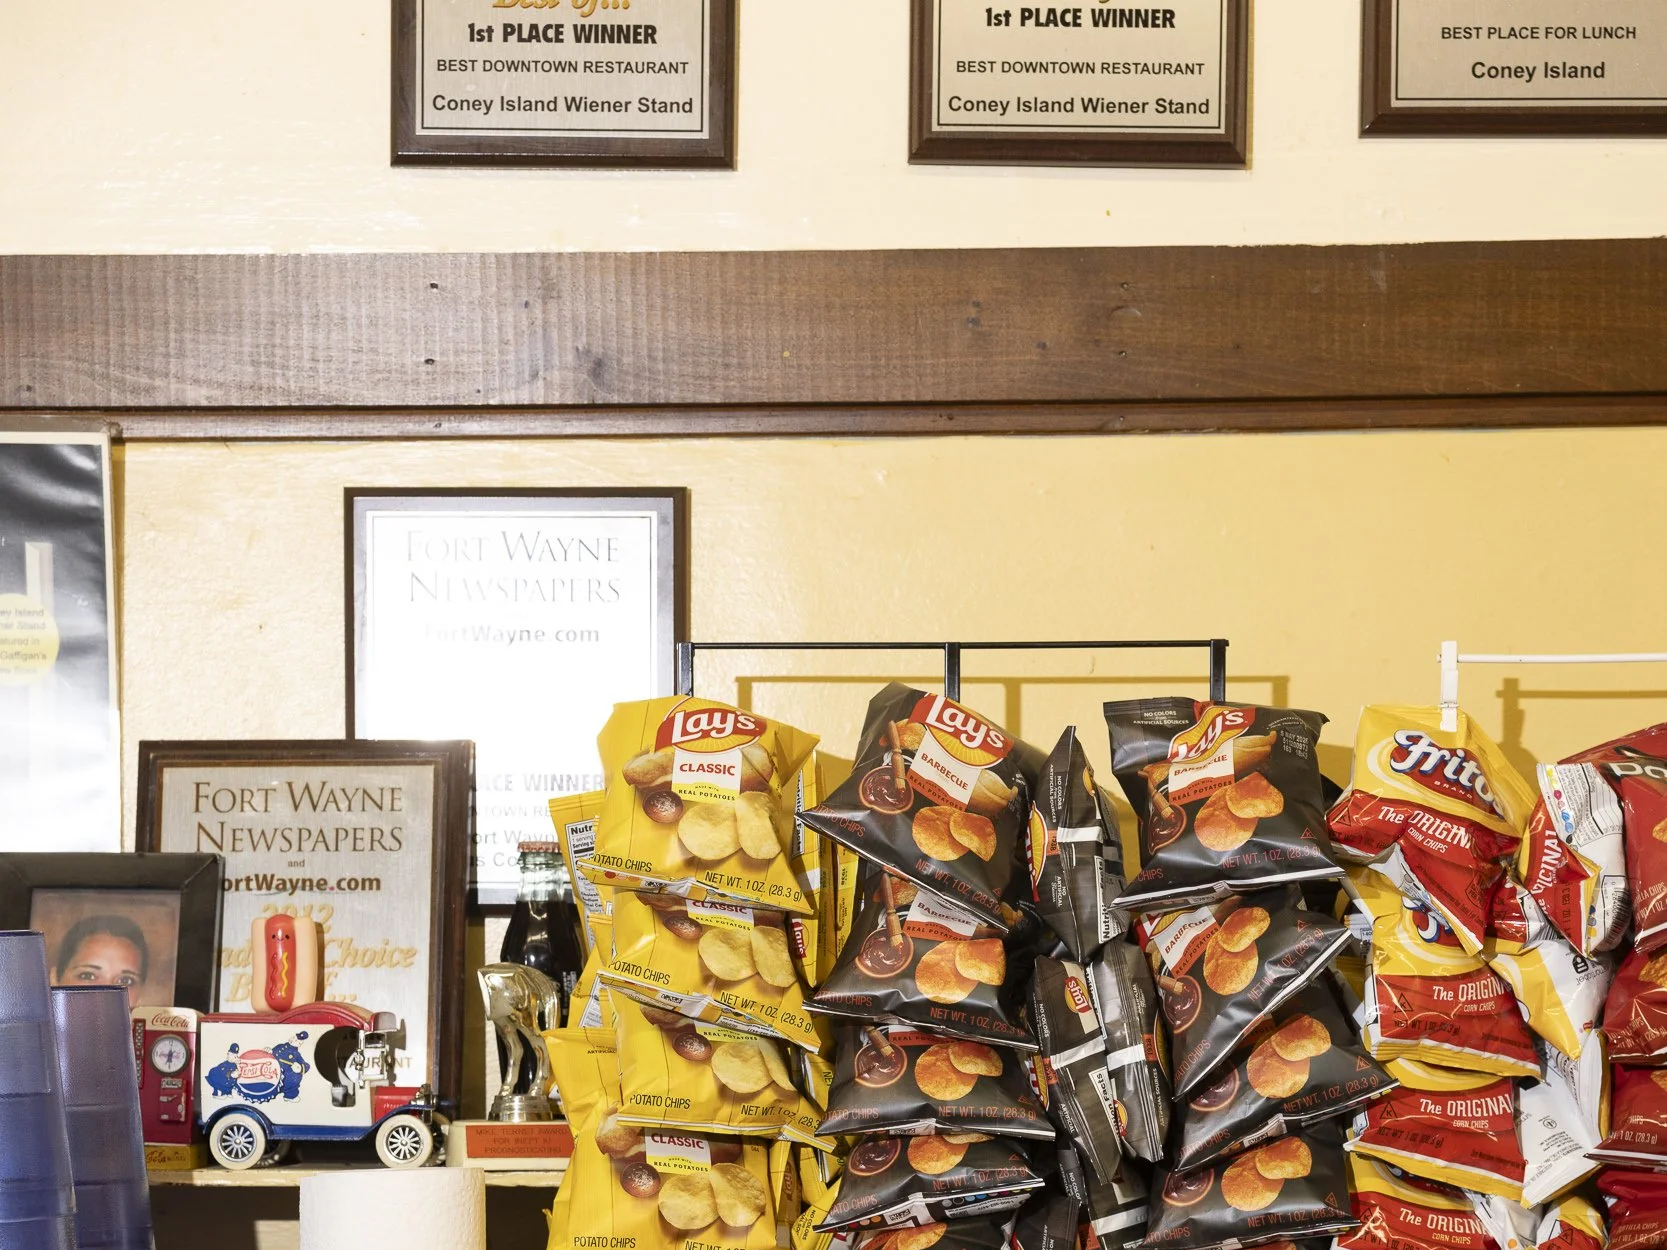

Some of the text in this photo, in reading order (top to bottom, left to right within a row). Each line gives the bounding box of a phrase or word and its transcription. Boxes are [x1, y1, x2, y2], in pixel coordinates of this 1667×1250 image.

[985, 8, 1175, 29] 1st PLACE WINNER
[468, 23, 657, 44] 1st PLACE WINNER
[1441, 27, 1637, 39] BEST PLACE FOR LUNCH
[436, 59, 689, 75] BEST DOWNTOWN RESTAURANT
[956, 60, 1204, 75] BEST DOWNTOWN RESTAURANT
[1471, 61, 1605, 83] Coney Island
[432, 94, 693, 115] Coney Island Wiener Stand
[949, 95, 1210, 116] Coney Island Wiener Stand
[672, 711, 757, 744] Lay's
[679, 763, 736, 776] CLASSIC
[921, 753, 969, 791] BARBECUE
[523, 774, 605, 791] WINNER
[286, 781, 404, 813] WAYNE
[678, 789, 736, 801] REAL POTATOES
[1378, 805, 1404, 825] The
[195, 821, 404, 852] NEWSPAPERS
[839, 815, 866, 838] CHIPS
[1408, 827, 1424, 843] CORN
[1423, 834, 1449, 854] CHIPS
[287, 858, 305, 868] and
[625, 859, 652, 873] CHIPS
[915, 858, 934, 876] NET
[1137, 853, 1261, 882] CHIPS NET WT.
[222, 872, 381, 896] ortWayne.com
[705, 870, 791, 899] NET WT. OZ. (28.3
[643, 968, 671, 985] CHIPS
[1432, 985, 1454, 1001] The
[721, 990, 803, 1029] NET WT. OZ. (28.3
[846, 994, 967, 1025] CHIPS NET WT.
[1479, 1001, 1496, 1012] CHIPS
[1190, 1039, 1213, 1065] CHIPS
[1284, 1099, 1302, 1113] NET
[1345, 1077, 1367, 1094] (28.3
[630, 1094, 760, 1117] POTATO CHIPS NET
[852, 1106, 1025, 1121] CHIPS NET WT. (28.3
[1420, 1098, 1442, 1115] The
[1453, 1119, 1489, 1129] CORN CHIPS
[651, 1132, 704, 1149] CLASSIC
[1207, 1128, 1231, 1147] CHIPS
[674, 1163, 708, 1172] POTATOES
[850, 1195, 878, 1211] CHIPS
[1400, 1207, 1422, 1227] The
[1163, 1227, 1191, 1240] CHIPS
[1247, 1216, 1266, 1228] NET
[573, 1236, 608, 1249] POTATO
[610, 1237, 636, 1249] CHIPS
[1432, 1232, 1471, 1245] CORN CHIPS
